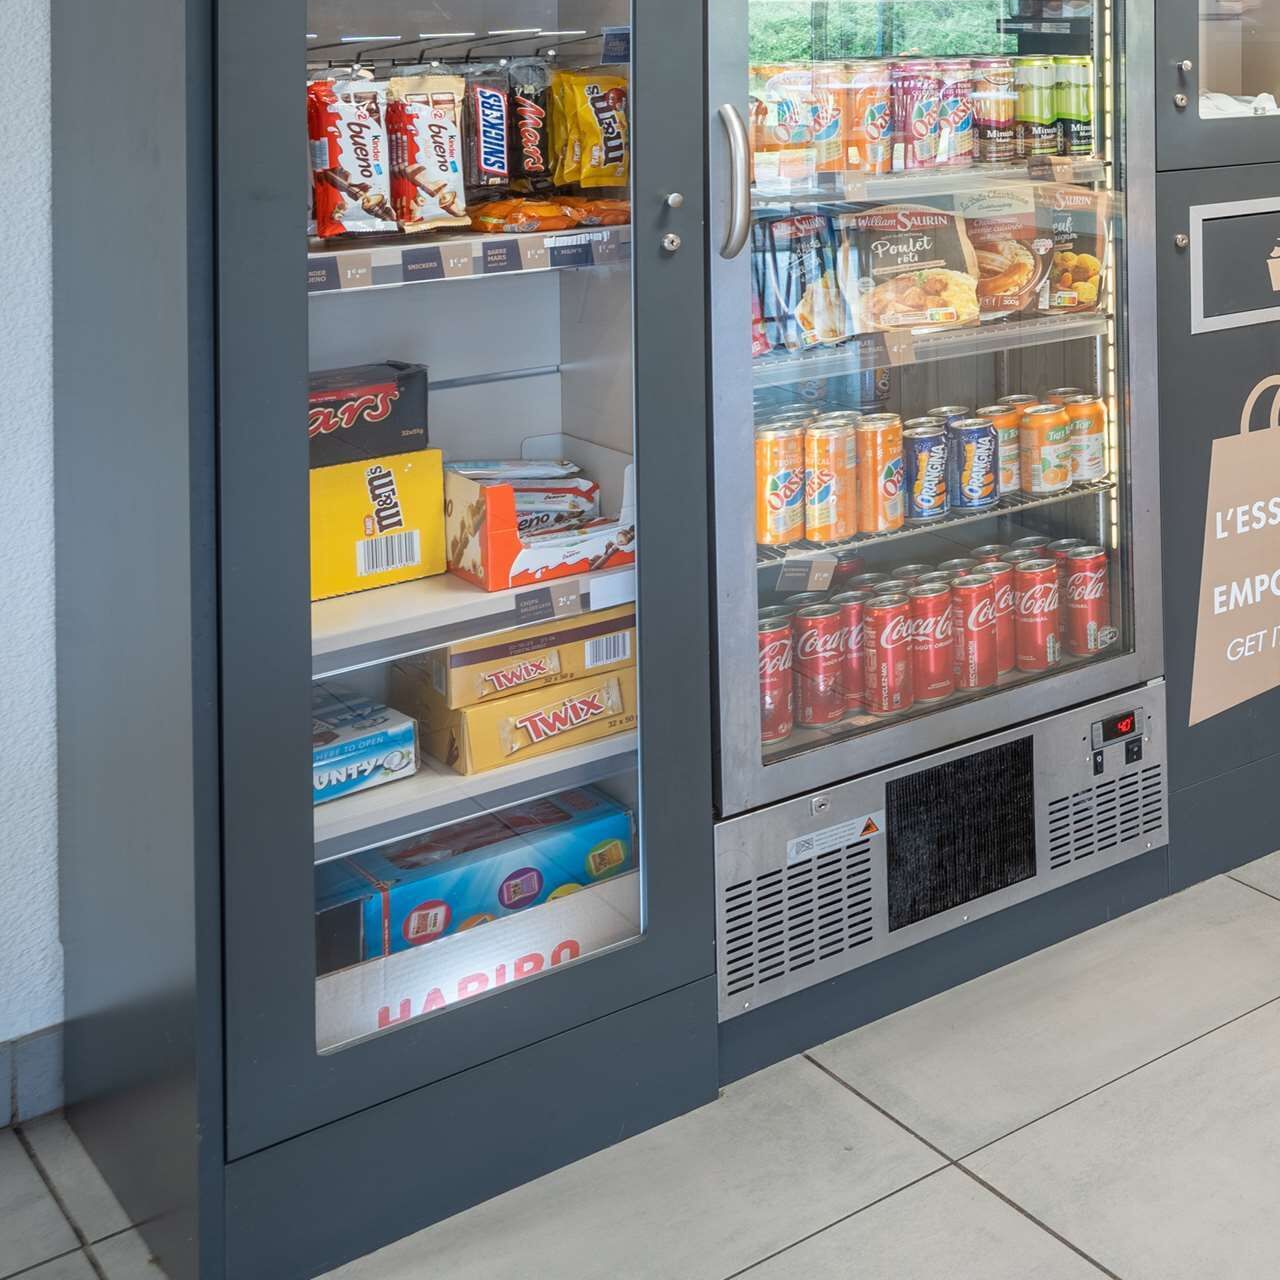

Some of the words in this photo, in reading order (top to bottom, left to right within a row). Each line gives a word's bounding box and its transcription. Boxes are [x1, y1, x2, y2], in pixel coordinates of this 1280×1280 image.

[479, 90, 505, 170] SNICKERS
[514, 96, 546, 171] Mars
[347, 122, 373, 178] bueno
[371, 134, 382, 161] Kinder
[428, 123, 449, 172] bueno
[1055, 191, 1092, 210] SAURIN
[858, 215, 896, 227] William
[896, 210, 948, 232] SAURIN
[871, 236, 933, 258] Poulet
[407, 262, 438, 271] SNICKERS
[308, 391, 400, 438] ars
[918, 444, 945, 506] ORANGINA
[966, 435, 992, 498] ORANGINA
[805, 469, 835, 498] asis
[1227, 630, 1267, 661] GET
[344, 744, 356, 754] TO
[359, 735, 385, 750] OPEN
[313, 758, 378, 790] UNTY
